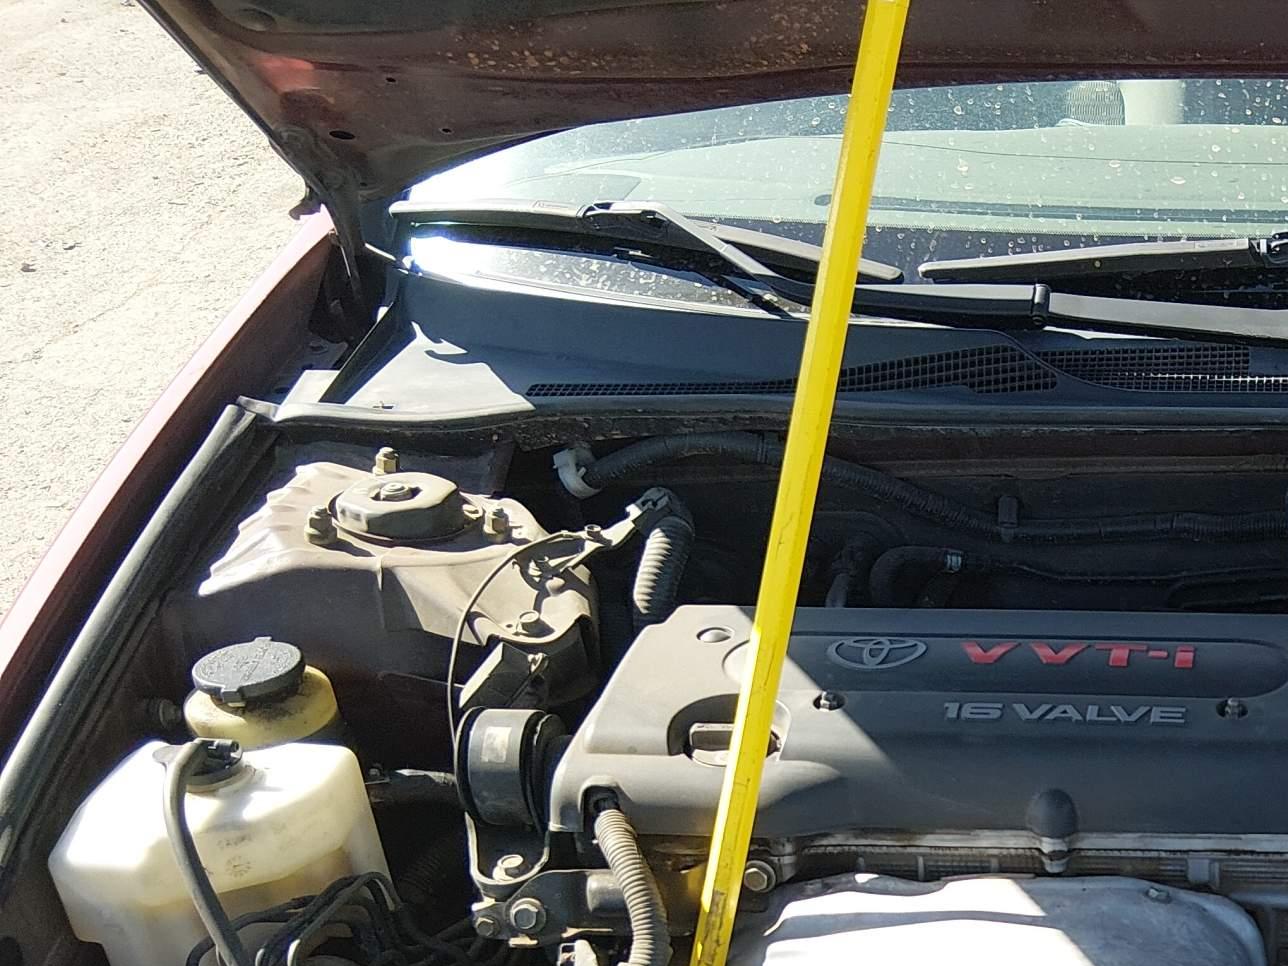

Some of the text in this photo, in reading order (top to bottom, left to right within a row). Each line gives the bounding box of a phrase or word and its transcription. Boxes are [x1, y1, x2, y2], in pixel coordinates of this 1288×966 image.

[960, 640, 1196, 669] VVT-i
[943, 702, 1187, 724] 16 VALVE
